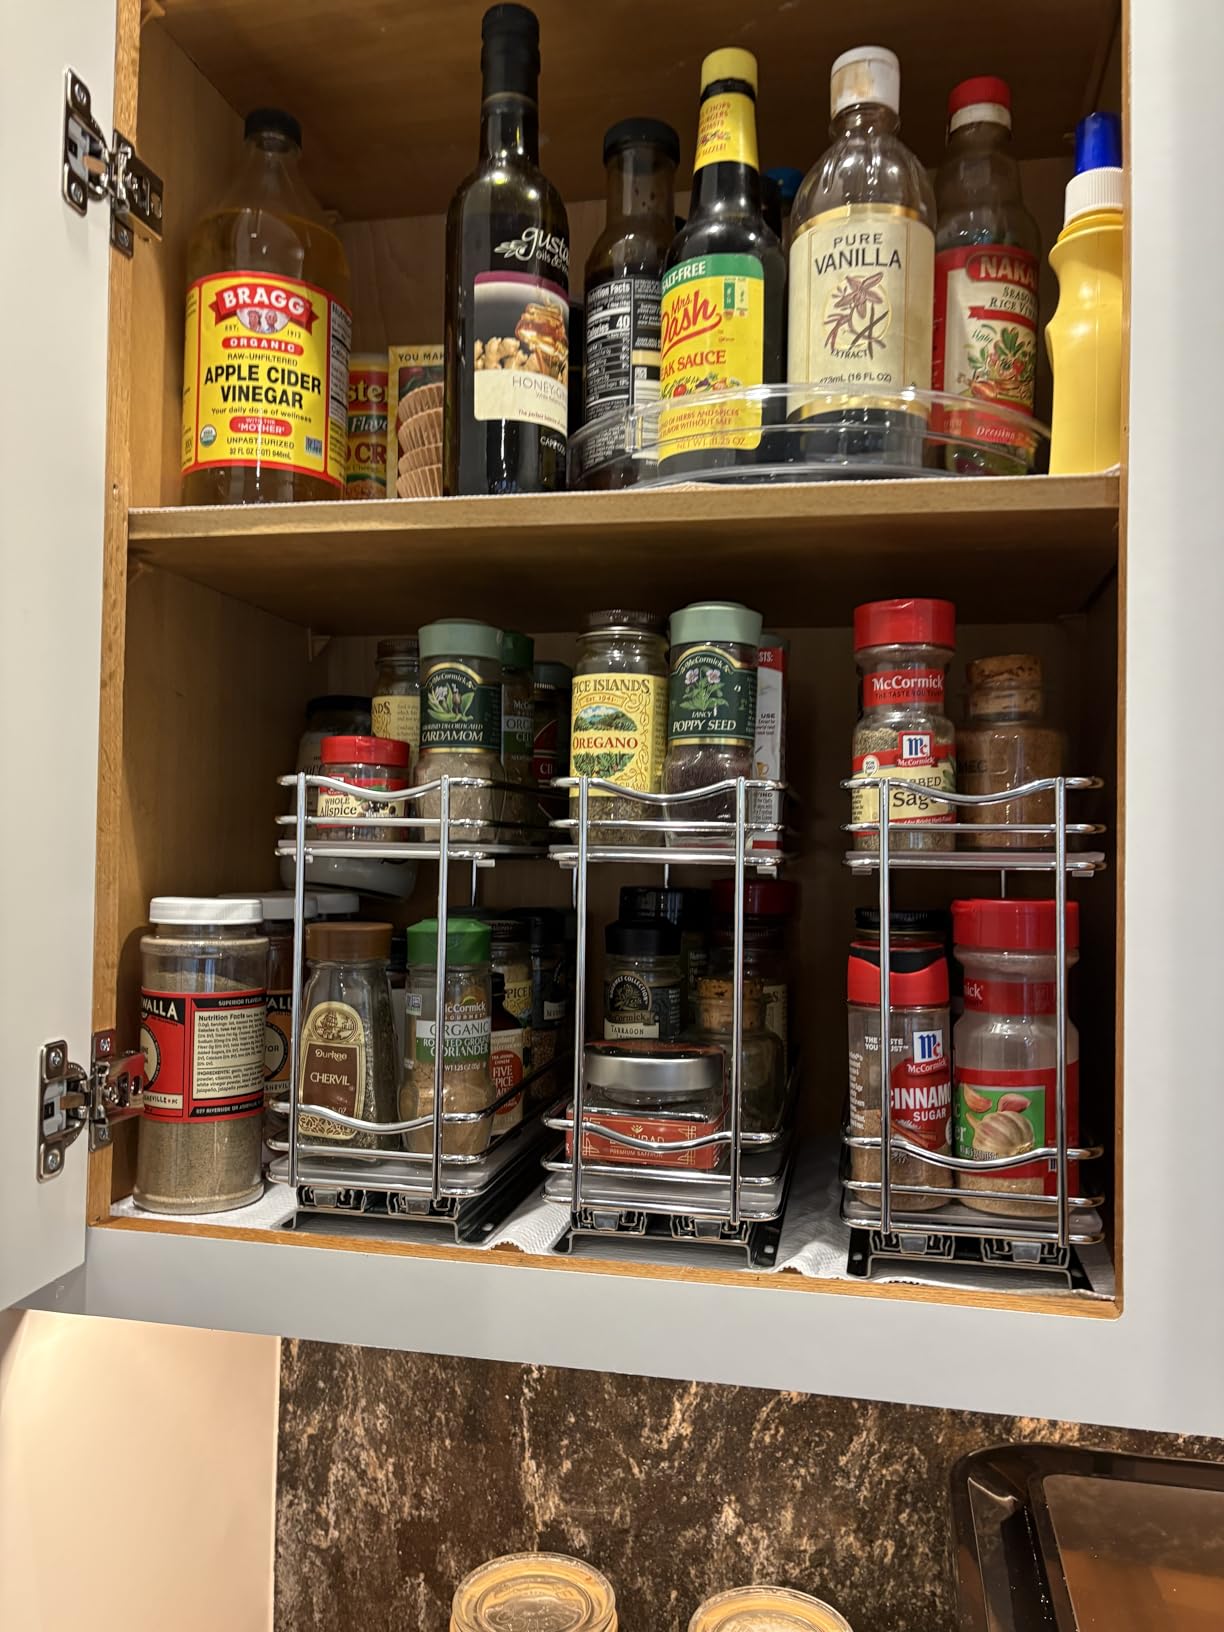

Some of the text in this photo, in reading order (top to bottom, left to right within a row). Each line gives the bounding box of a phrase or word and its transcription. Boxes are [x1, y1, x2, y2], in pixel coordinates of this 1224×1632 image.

[833, 232, 884, 250] PURE
[814, 249, 903, 276] VANILLA
[610, 282, 631, 295] Facts
[222, 287, 304, 315] BRAGG
[989, 296, 1017, 312] RICE
[615, 314, 631, 329] 40
[229, 338, 296, 353] ORGANIC
[227, 352, 298, 367] RAW-UNFILTERED
[398, 352, 419, 362] YOU
[676, 349, 727, 372] SAUCE
[831, 349, 869, 359] EXTRACT
[204, 364, 321, 395] APPLE CIDER
[863, 372, 875, 381] FL
[220, 384, 304, 410] VINEGAR
[211, 407, 227, 415] Your
[228, 405, 247, 415] daily
[270, 408, 279, 417] of
[280, 411, 312, 424] wellness
[237, 447, 244, 456] FL
[245, 448, 254, 456] OZ
[593, 678, 651, 695] ISLANDS
[872, 674, 944, 692] McCormick
[672, 719, 737, 733] POPPY SEED
[422, 730, 484, 743] CARDAMOM
[572, 736, 639, 750] OREGANO
[896, 756, 936, 767] McCormick
[325, 797, 350, 806] WHOLE
[893, 790, 938, 810] Sag
[320, 805, 358, 817] Allspice
[444, 1001, 487, 1013] cCormick
[198, 1012, 245, 1022] Nutrition Facts
[610, 1024, 645, 1035] TARRAGON
[423, 1038, 463, 1047] ROTED
[864, 1036, 878, 1044] THE
[864, 1043, 879, 1051] YOU
[315, 1048, 348, 1063] Durkee
[493, 1064, 513, 1078] FIVE
[906, 1057, 946, 1073] McCormick
[310, 1071, 351, 1086] CHERVIL
[912, 1107, 947, 1122] SUGAR
[609, 1148, 635, 1156] PREMIUM
